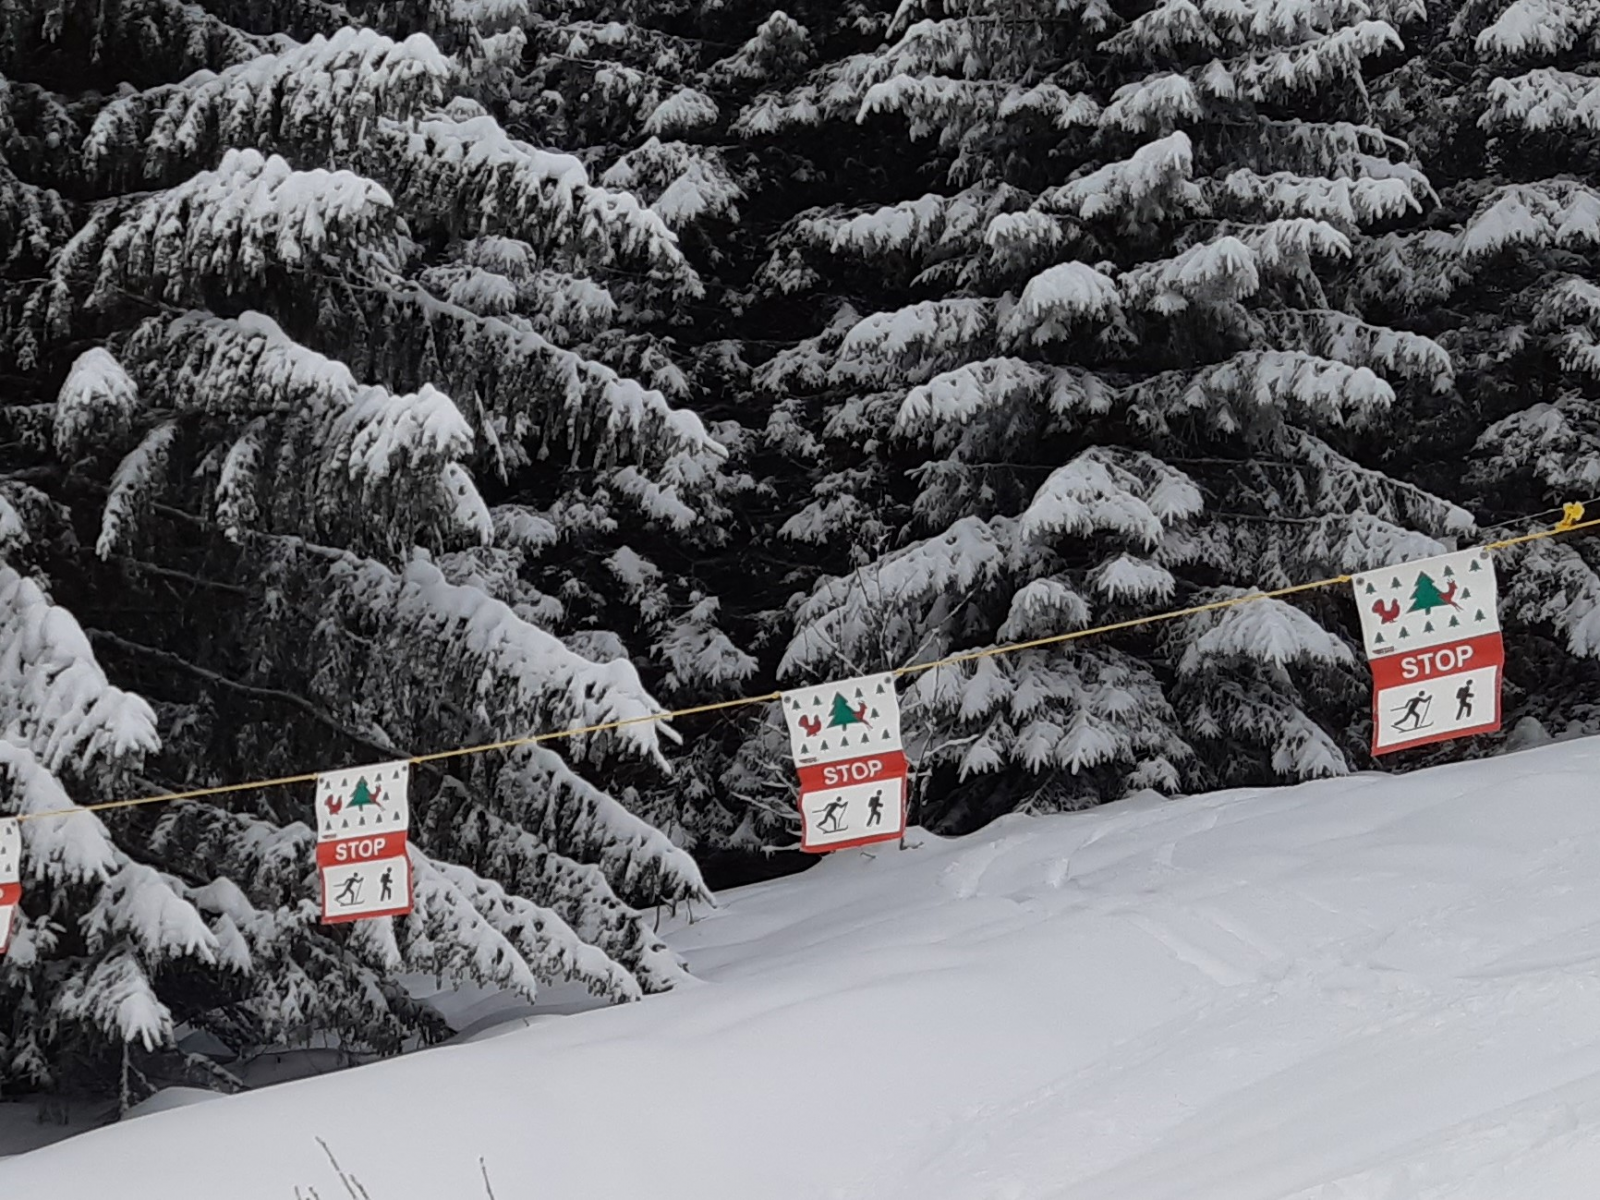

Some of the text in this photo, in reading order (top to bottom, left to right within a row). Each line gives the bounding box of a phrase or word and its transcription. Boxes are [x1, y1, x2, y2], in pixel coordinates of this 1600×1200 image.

[1401, 645, 1474, 679] STOP
[823, 760, 883, 785] STOP
[335, 838, 386, 861] STOP
